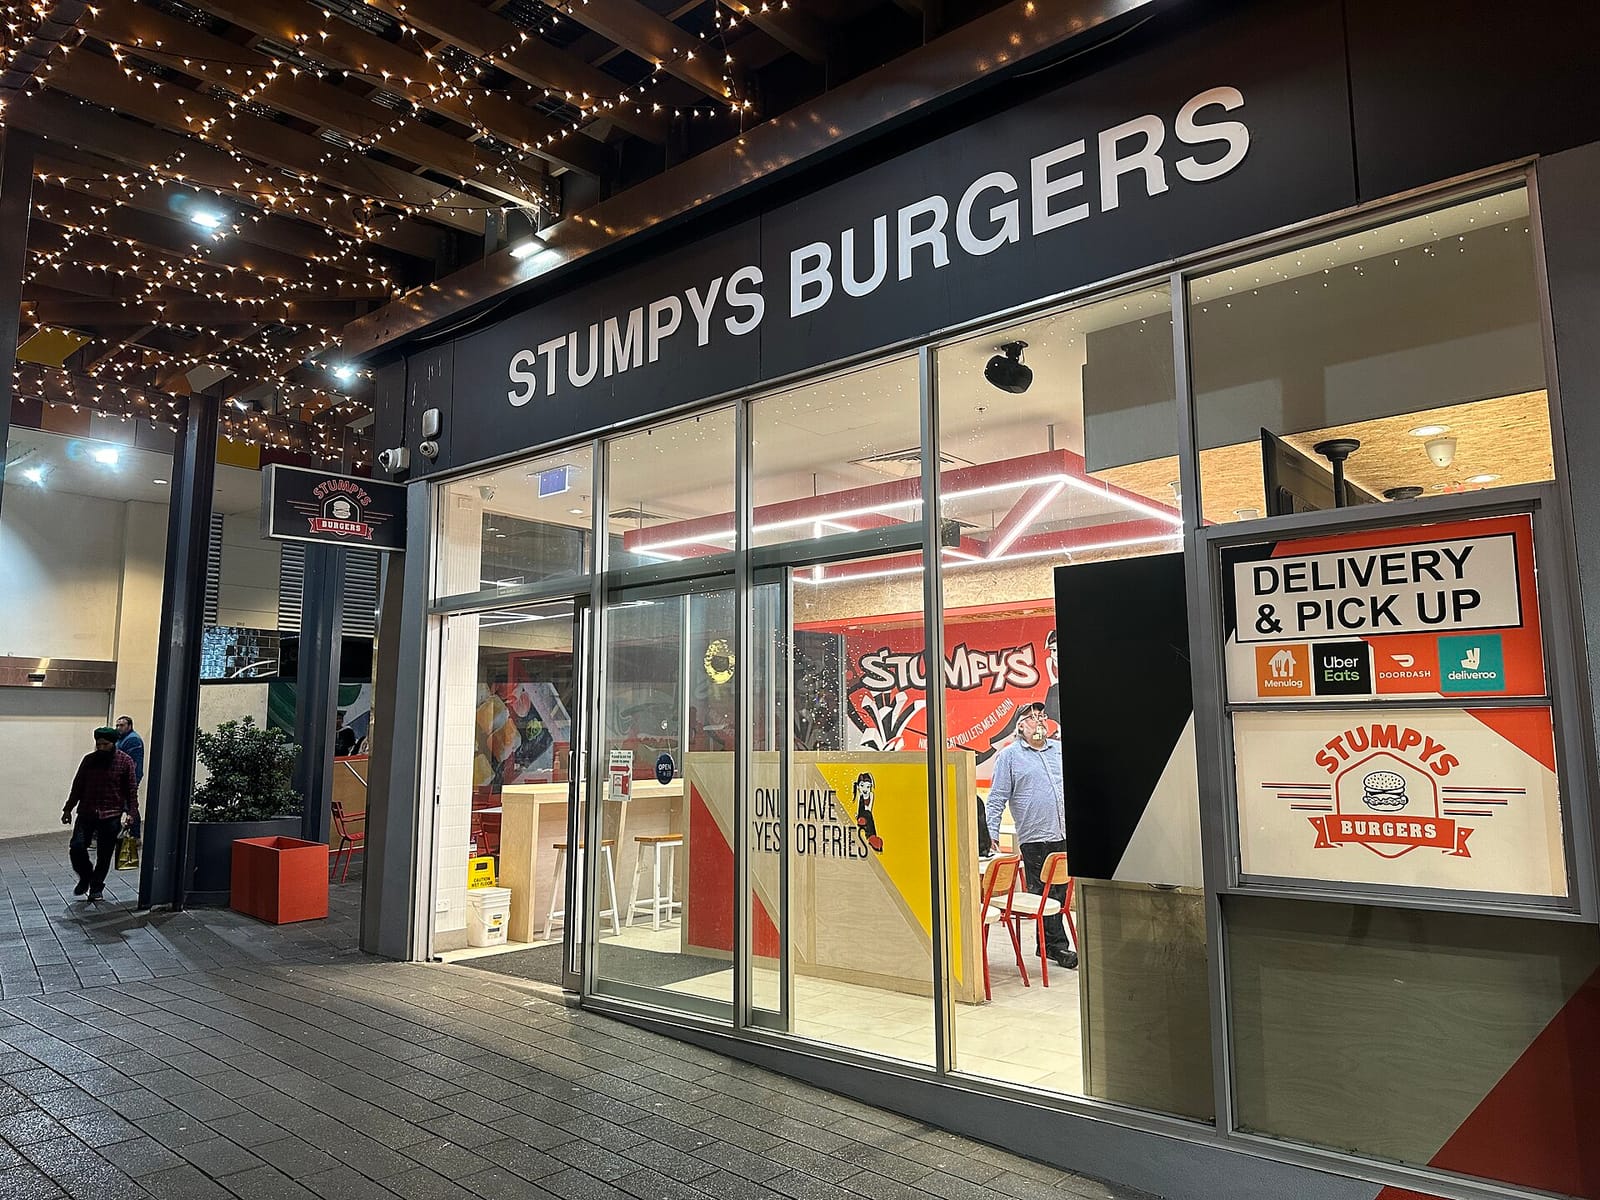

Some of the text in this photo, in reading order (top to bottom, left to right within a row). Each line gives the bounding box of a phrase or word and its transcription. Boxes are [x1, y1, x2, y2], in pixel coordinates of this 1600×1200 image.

[507, 86, 1252, 408] STUMPYS BURGERS
[313, 480, 372, 505] STUMPYS
[322, 521, 361, 531] BURGERS
[1253, 546, 1474, 595] DELIVERY
[1255, 588, 1481, 634] & PICK UP
[1323, 656, 1359, 668] Uber
[1264, 678, 1303, 688] Menulog
[1324, 669, 1360, 682] Eats
[1379, 670, 1431, 679] DOORDASH
[1448, 670, 1496, 680] deliveroo
[983, 714, 998, 733] MEAT
[995, 697, 1014, 719] AGAIN
[1315, 724, 1459, 776] STUMPYS
[658, 763, 672, 771] OPEN
[755, 788, 837, 820] ONL HAVE
[1341, 820, 1437, 838] BURGERS
[752, 821, 868, 859] YES OR FRIES
